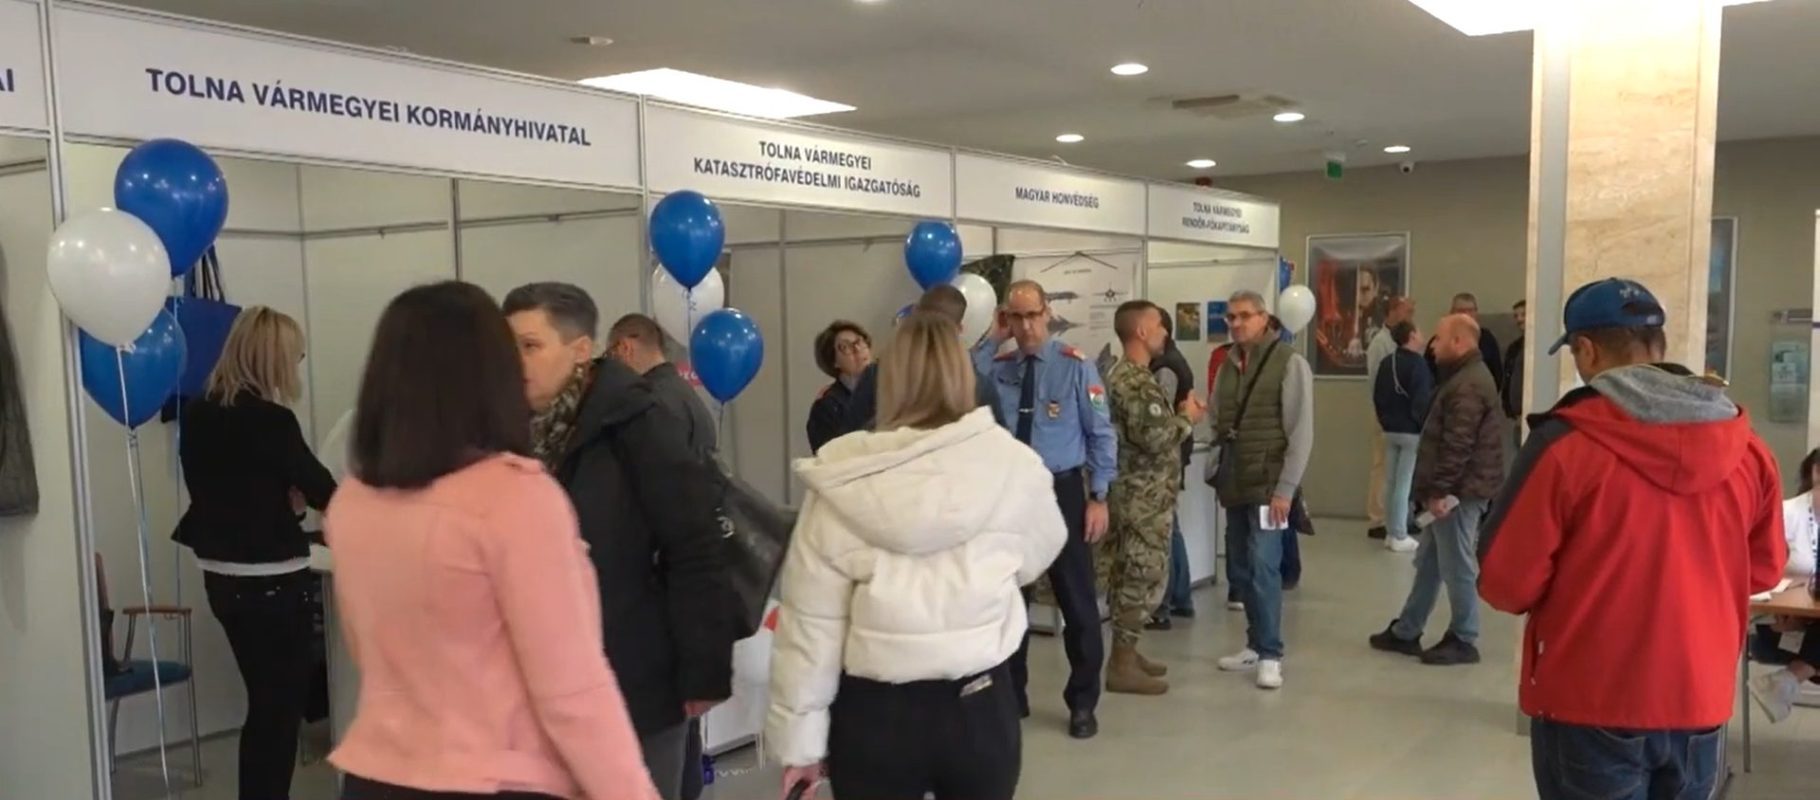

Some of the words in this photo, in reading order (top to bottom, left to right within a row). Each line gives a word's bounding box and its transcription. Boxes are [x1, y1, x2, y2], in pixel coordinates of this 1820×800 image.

[145, 68, 245, 103] TOLNA
[252, 80, 400, 122] VÁRMEGYEI
[407, 104, 591, 147] KORMÁNYHIVATAL
[759, 141, 801, 161] TOLNA
[804, 145, 872, 170] VÁRMEGYEI
[694, 157, 841, 189] KATASZTRÓFAVÉDELMI
[844, 176, 921, 198] IGAZGATÓSÁG
[1015, 186, 1050, 203] MAGYAR
